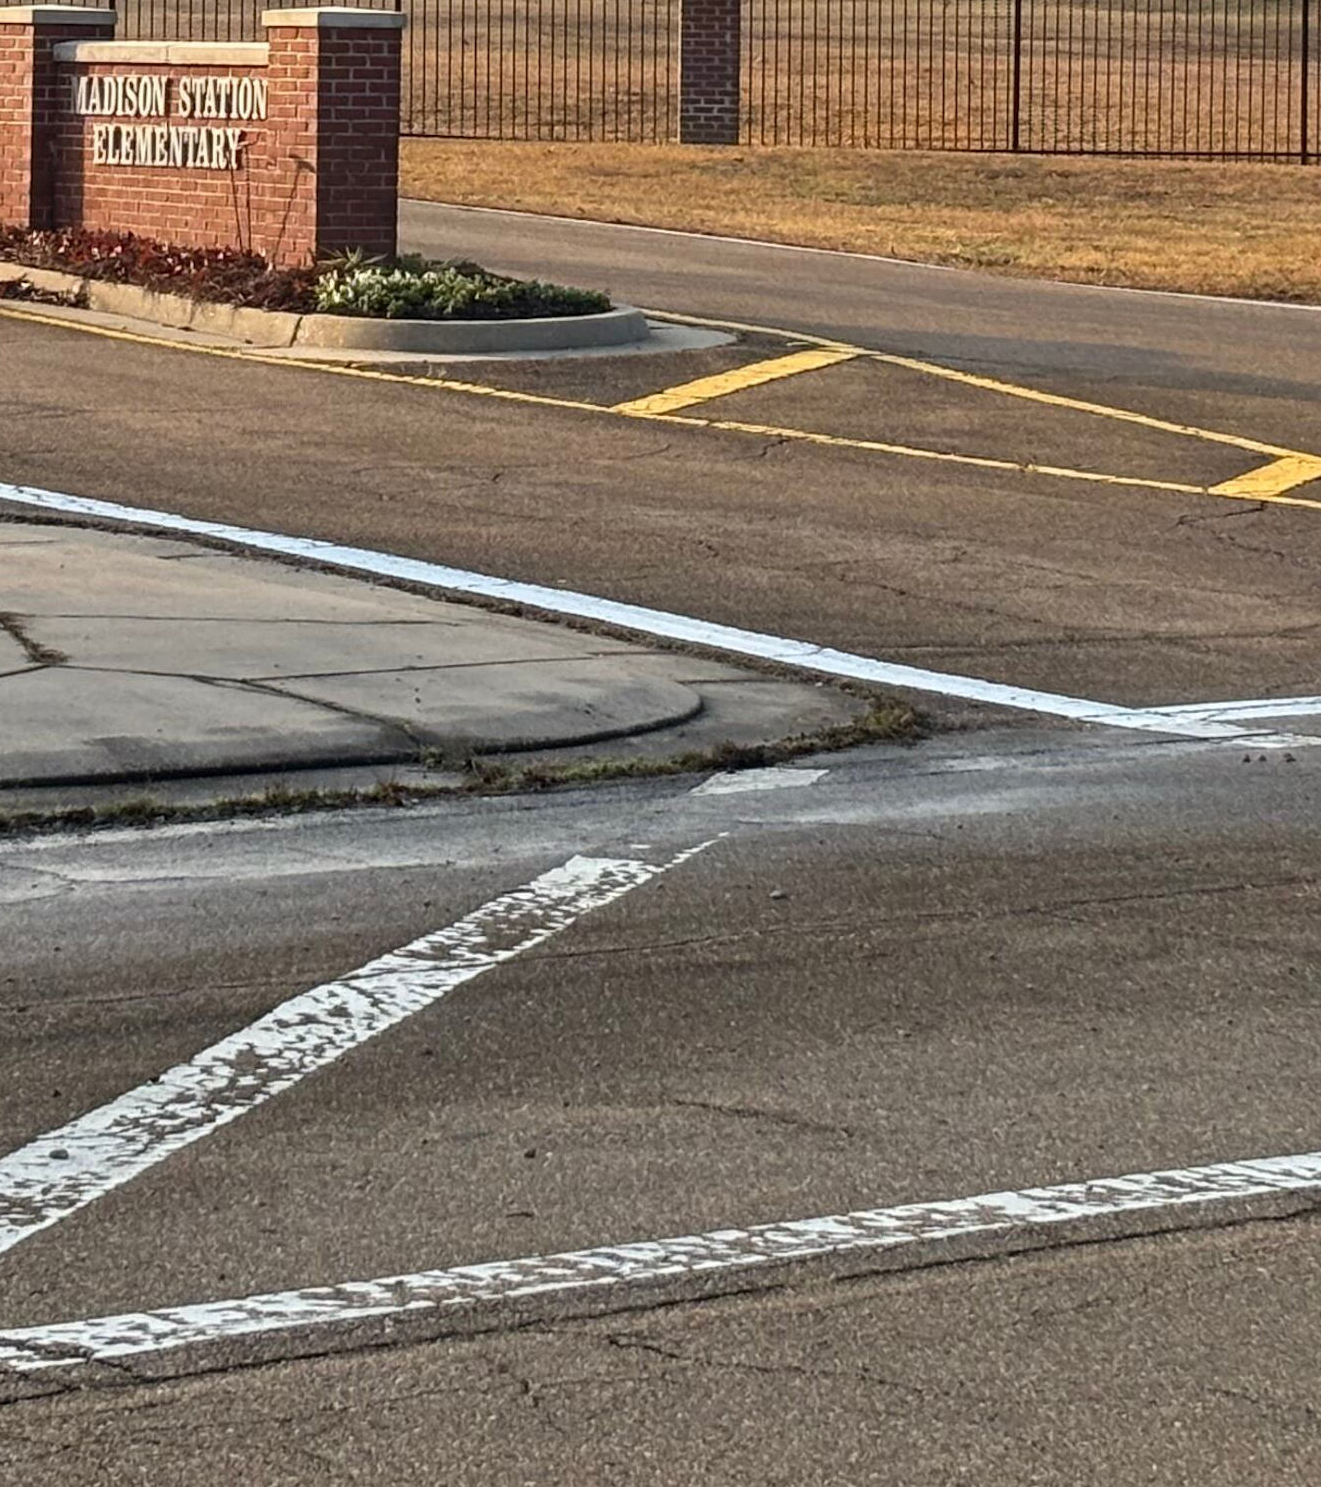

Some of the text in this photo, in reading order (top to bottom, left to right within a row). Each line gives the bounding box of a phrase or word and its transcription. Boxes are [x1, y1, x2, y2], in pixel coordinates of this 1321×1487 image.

[72, 76, 268, 120] MADISON STATION
[93, 124, 241, 170] ELEMENTARY
